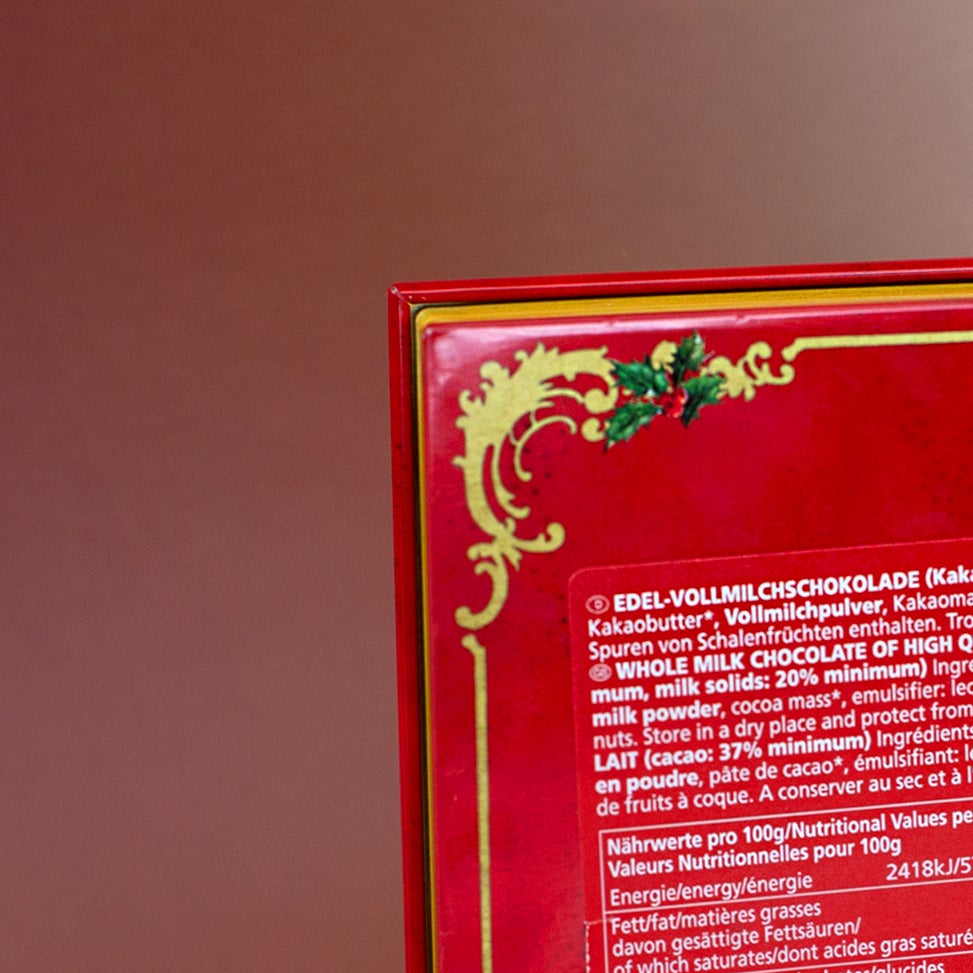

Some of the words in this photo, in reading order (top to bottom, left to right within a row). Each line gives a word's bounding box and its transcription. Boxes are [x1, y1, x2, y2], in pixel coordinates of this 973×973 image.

[613, 570, 920, 612] EDEL-VOLLMILCHSCHOKOLADE
[723, 597, 887, 626] Vollmilchpulver,
[615, 656, 689, 680] WHOLE
[693, 651, 745, 673] MILK
[749, 641, 867, 669] CHOCOLATE
[871, 639, 899, 658] OF
[903, 635, 953, 656] HIGH
[591, 685, 649, 704] mum,
[654, 676, 700, 698] milk
[704, 671, 770, 694] solids:
[774, 667, 819, 688] 20%
[823, 657, 927, 684] minimum)
[593, 730, 638, 749] nuts.
[642, 724, 692, 745] Store
[696, 722, 714, 740] in
[718, 724, 730, 739] a
[734, 718, 765, 740] dry
[769, 714, 817, 739] place
[821, 709, 856, 730] and
[860, 705, 926, 731] protect
[929, 701, 973, 720] from
[593, 750, 639, 772] LAIT
[643, 748, 713, 770] (cacao:
[718, 740, 763, 761] 37%
[767, 728, 871, 757] minimum)
[607, 832, 703, 856] Nährwerte
[707, 831, 738, 851] pro
[742, 813, 886, 845] 100g/Nutritional
[890, 809, 948, 830] Values
[607, 857, 674, 878] Valeurs
[678, 842, 809, 871] Nutritionnelles
[813, 842, 855, 863] pour
[860, 835, 901, 856] 100g
[610, 871, 813, 908] Energie/energy/énergie
[610, 907, 756, 935] Fett/fat/matières
[759, 902, 821, 925] grasses
[612, 938, 666, 957] davon
[670, 929, 759, 957] gesättigte
[763, 916, 862, 943] Fettsäuren/
[693, 944, 819, 971] saturates/dont
[823, 938, 876, 959] acides
[879, 937, 916, 958] gras
